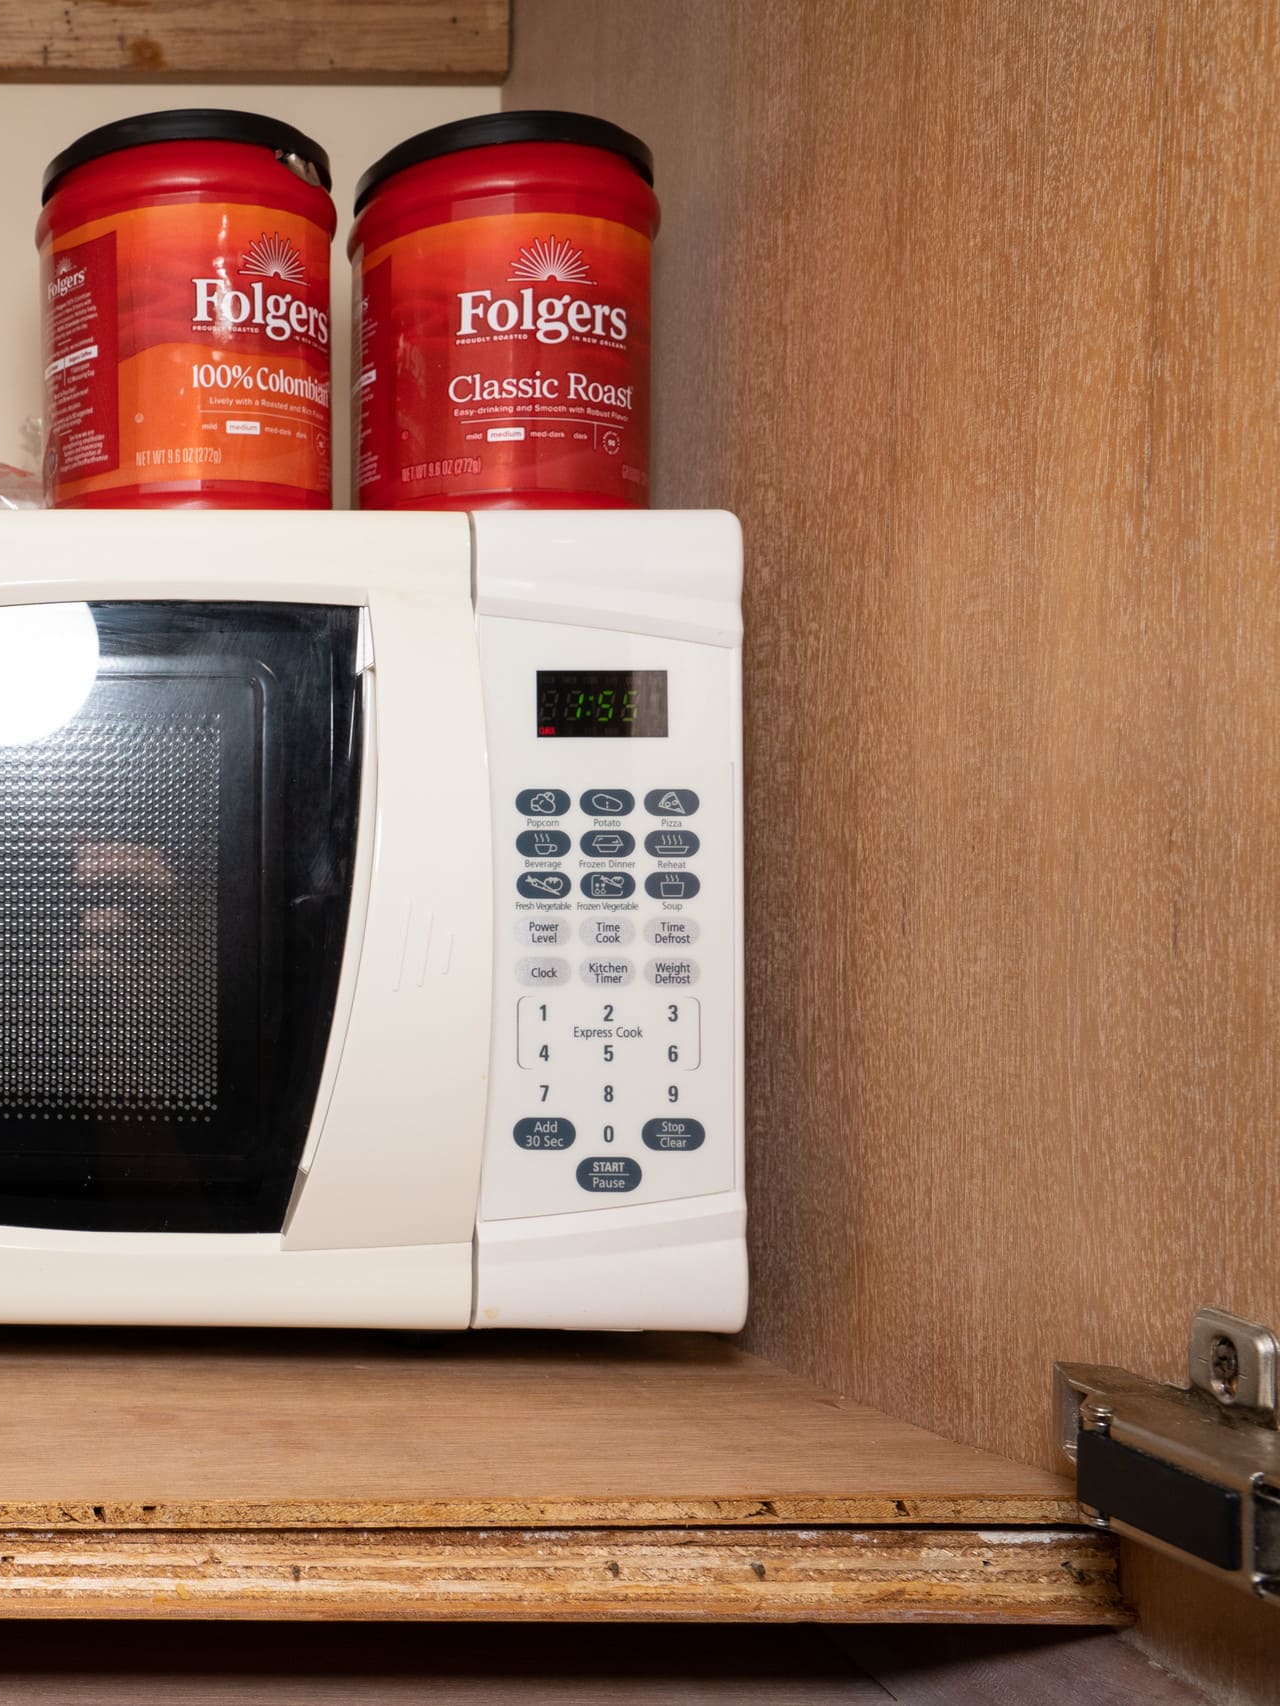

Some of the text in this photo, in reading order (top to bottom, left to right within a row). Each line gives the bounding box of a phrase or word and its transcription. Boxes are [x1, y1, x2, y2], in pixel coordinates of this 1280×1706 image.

[47, 269, 86, 302] Folgers
[192, 278, 329, 344] Folgers
[456, 287, 628, 345] Folgers
[455, 333, 528, 346] PROUDLY ROASTED
[582, 336, 598, 344] NEW
[192, 363, 254, 390] 100%
[448, 371, 633, 410] Classic Roast
[209, 396, 234, 407] Lively
[235, 397, 253, 406] with
[261, 398, 289, 411] Roasted
[454, 403, 514, 417] Easy-drinking
[516, 402, 532, 413] and
[534, 403, 568, 414] Smooth
[568, 406, 585, 414] with
[586, 407, 610, 418] Robust
[202, 422, 218, 432] mild
[228, 423, 258, 432] medium
[465, 431, 483, 441] mild
[490, 430, 522, 440] medium
[529, 430, 565, 440] med-dark
[573, 431, 588, 441] dark
[136, 450, 150, 467] NET
[152, 449, 166, 465] WT
[182, 447, 194, 464] OZ
[195, 447, 222, 465] (272g)
[401, 466, 414, 482] NET
[415, 463, 427, 480] WT
[442, 459, 454, 475] OZ
[454, 456, 481, 475] (272g)
[575, 689, 639, 722] 1:55
[526, 818, 560, 828] Popcorn
[593, 818, 621, 828] Potato
[661, 818, 683, 828] Pizza
[524, 859, 562, 870] Beverage
[578, 860, 636, 869] Frozen Dinner
[657, 860, 686, 869] Reheat
[515, 902, 571, 911] Fresh Vegetable
[577, 902, 639, 911] Frozen Vegetable
[662, 901, 683, 912] Soup
[528, 921, 559, 932] Power
[596, 921, 620, 932] Time
[660, 921, 685, 932] Time
[531, 933, 557, 944] Level
[595, 933, 621, 944] Cook
[654, 933, 691, 944] Defrost
[531, 967, 557, 978] Clock
[588, 962, 628, 973] Kitchen
[655, 962, 691, 975] Weight
[595, 973, 622, 984] Timer
[655, 974, 691, 984] Defrost
[539, 1004, 547, 1022] 1
[603, 1004, 614, 1022] 2
[667, 1004, 679, 1022] 3
[573, 1026, 643, 1040] Express Cook
[539, 1044, 550, 1062] 4
[603, 1044, 614, 1062] 5
[667, 1044, 679, 1062] 6
[539, 1085, 550, 1102] 7
[603, 1085, 614, 1103] 8
[668, 1085, 679, 1103] 9
[533, 1121, 558, 1133] Add
[661, 1120, 685, 1134] Stop
[603, 1125, 614, 1143] 0
[526, 1136, 564, 1147] 30 Sec
[660, 1137, 687, 1148] Clear
[592, 1162, 625, 1173] START
[592, 1177, 626, 1189] Pause
